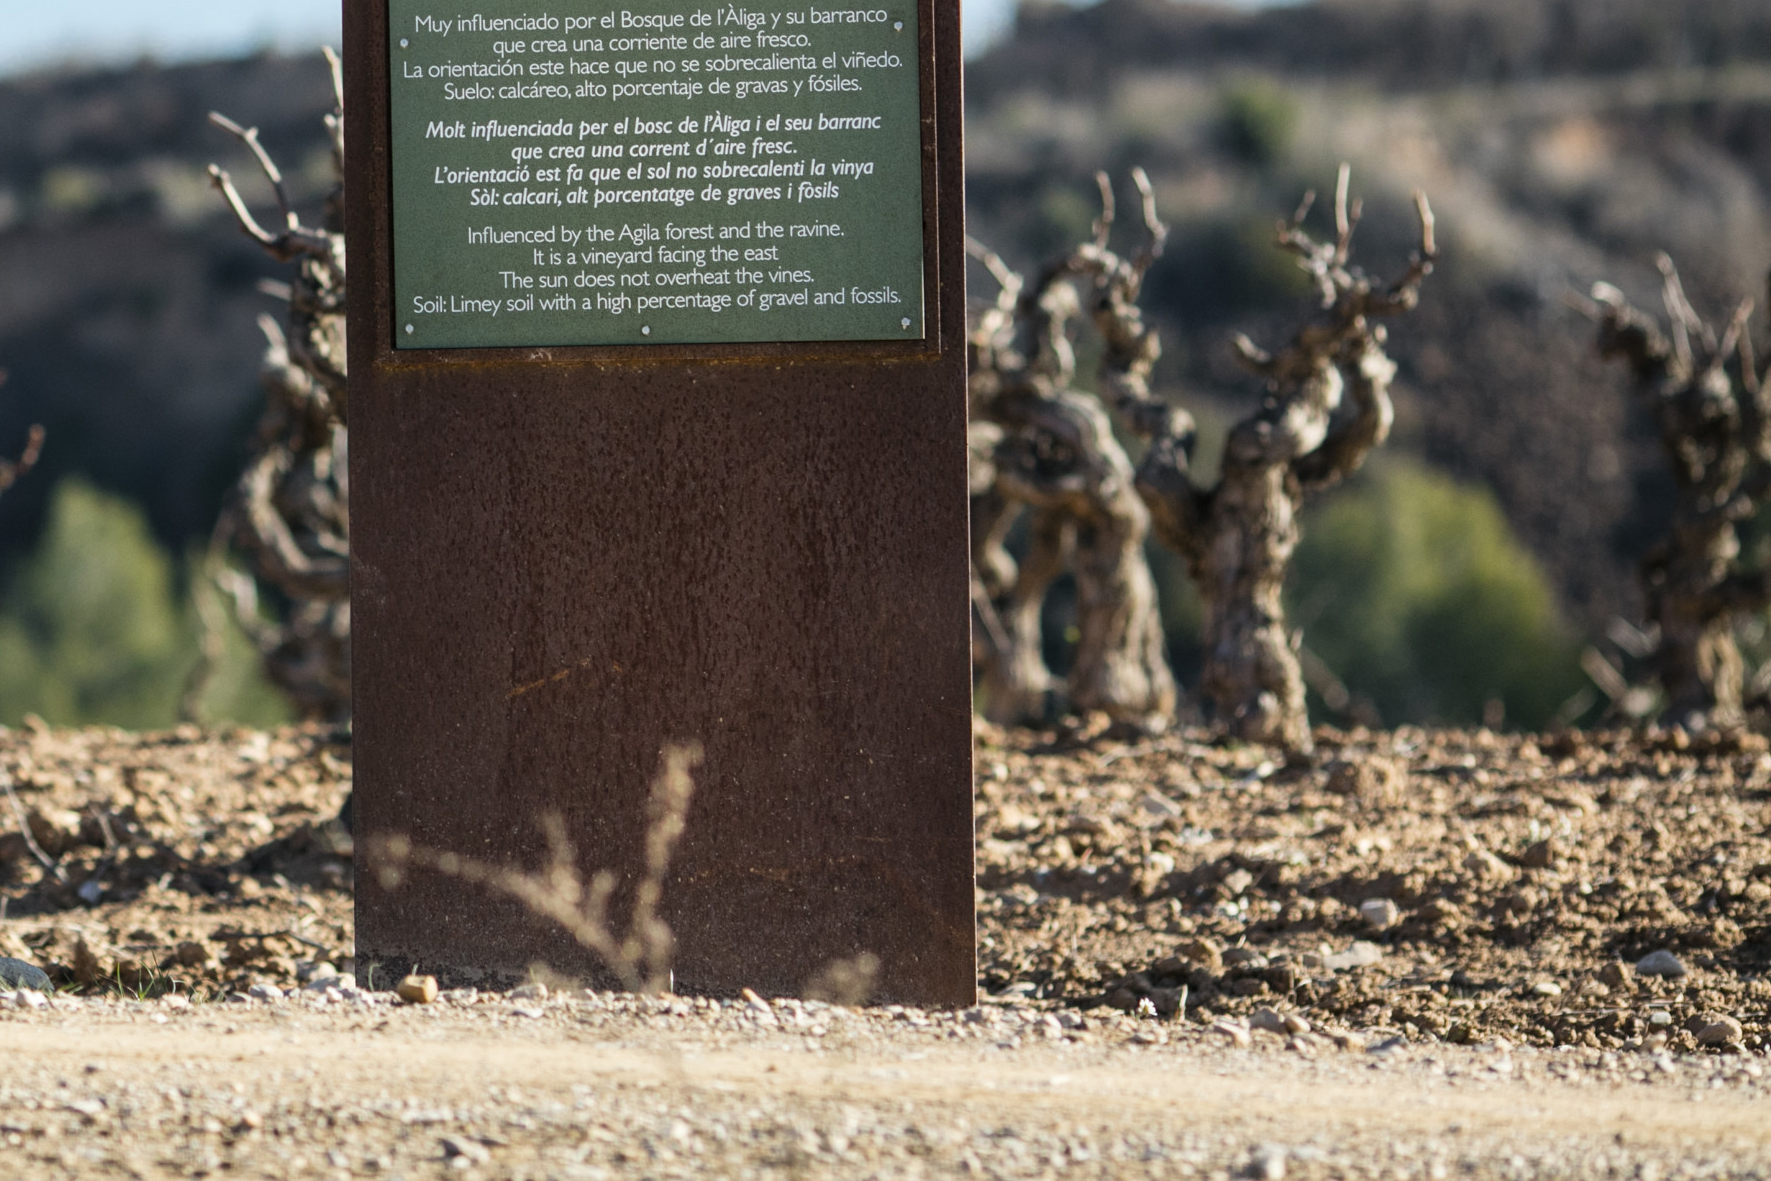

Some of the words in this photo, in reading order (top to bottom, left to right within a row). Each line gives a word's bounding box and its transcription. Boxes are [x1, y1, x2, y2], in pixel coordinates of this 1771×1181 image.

[415, 15, 453, 37] Muy
[457, 12, 559, 32] influenciado
[565, 16, 597, 34] por
[600, 11, 615, 29] el
[621, 10, 684, 32] Bosque
[689, 9, 712, 27] de
[770, 12, 781, 30] y
[786, 12, 805, 25] su
[810, 6, 888, 24] barranco
[493, 40, 526, 58] que
[531, 39, 568, 53] crea
[573, 39, 604, 52] una
[609, 33, 687, 51] corriente
[693, 31, 715, 49] de
[720, 31, 751, 49] aire
[756, 30, 811, 48] fresco.
[403, 61, 424, 78] La
[428, 58, 523, 78] orientación
[529, 60, 564, 76] este
[570, 57, 610, 75] hace
[614, 61, 648, 79] que
[653, 60, 676, 73] no
[681, 59, 700, 72] se
[705, 52, 817, 72] sobrecalienta
[822, 51, 836, 69] el
[841, 50, 903, 68] viñedo.
[444, 82, 495, 100] Suelo:
[498, 80, 572, 99] calcáreo,
[575, 79, 607, 97] alto
[612, 77, 703, 101] porcentaje
[708, 77, 731, 94] de
[735, 80, 788, 99] gravas
[792, 80, 804, 97] y
[808, 74, 862, 92] fósiles.
[425, 120, 466, 139] Molt
[471, 118, 573, 142] influenciada
[579, 120, 609, 141] per
[613, 116, 629, 135] el
[634, 116, 673, 135] bosc
[678, 115, 699, 134] de
[755, 115, 761, 132] i
[765, 113, 781, 132] el
[784, 118, 813, 131] seu
[818, 112, 882, 130] barranc
[511, 146, 543, 165] que
[548, 145, 585, 159] crea
[591, 144, 623, 158] una
[629, 141, 690, 157] corrent
[752, 136, 797, 159] fresc.
[536, 167, 561, 182] est
[566, 163, 583, 185] fa
[589, 167, 621, 186] que
[627, 162, 642, 180] el
[647, 161, 671, 180] sol
[676, 166, 697, 179] no
[703, 159, 805, 178] sobrecalenti
[810, 158, 826, 176] la
[831, 158, 874, 180] vinya
[470, 188, 500, 206] Sòl:
[503, 187, 562, 207] calcari,
[566, 186, 589, 204] alt
[593, 187, 695, 209] porcentatge
[700, 183, 722, 201] de
[726, 187, 782, 206] graves
[787, 182, 793, 199] i
[798, 181, 839, 203] fòsils
[468, 225, 556, 244] Influenced
[561, 225, 582, 247] by
[585, 224, 615, 242] the
[618, 223, 661, 246] Agila
[664, 222, 715, 240] forest
[719, 221, 751, 239] and
[754, 220, 784, 238] the
[789, 219, 844, 237] ravine.
[533, 248, 545, 266] It
[550, 248, 562, 265] is
[566, 252, 577, 265] a
[581, 246, 652, 269] vineyard
[657, 245, 706, 267] facing
[709, 244, 739, 262] the
[744, 245, 779, 261] east
[498, 271, 534, 289] The
[539, 275, 568, 288] sun
[573, 270, 616, 288] does
[620, 271, 651, 286] not
[655, 267, 731, 286] overheat
[734, 266, 764, 284] the
[768, 265, 815, 283] vines.
[413, 295, 447, 314] Soil:
[451, 295, 502, 317] Limey
[506, 293, 534, 312] soil
[538, 293, 576, 311] with
[582, 297, 592, 310] a
[597, 292, 632, 315] high
[637, 292, 732, 314] percentage
[736, 288, 757, 307] of
[759, 288, 808, 311] gravel
[813, 287, 845, 305] and
[850, 286, 902, 304] fossils.
